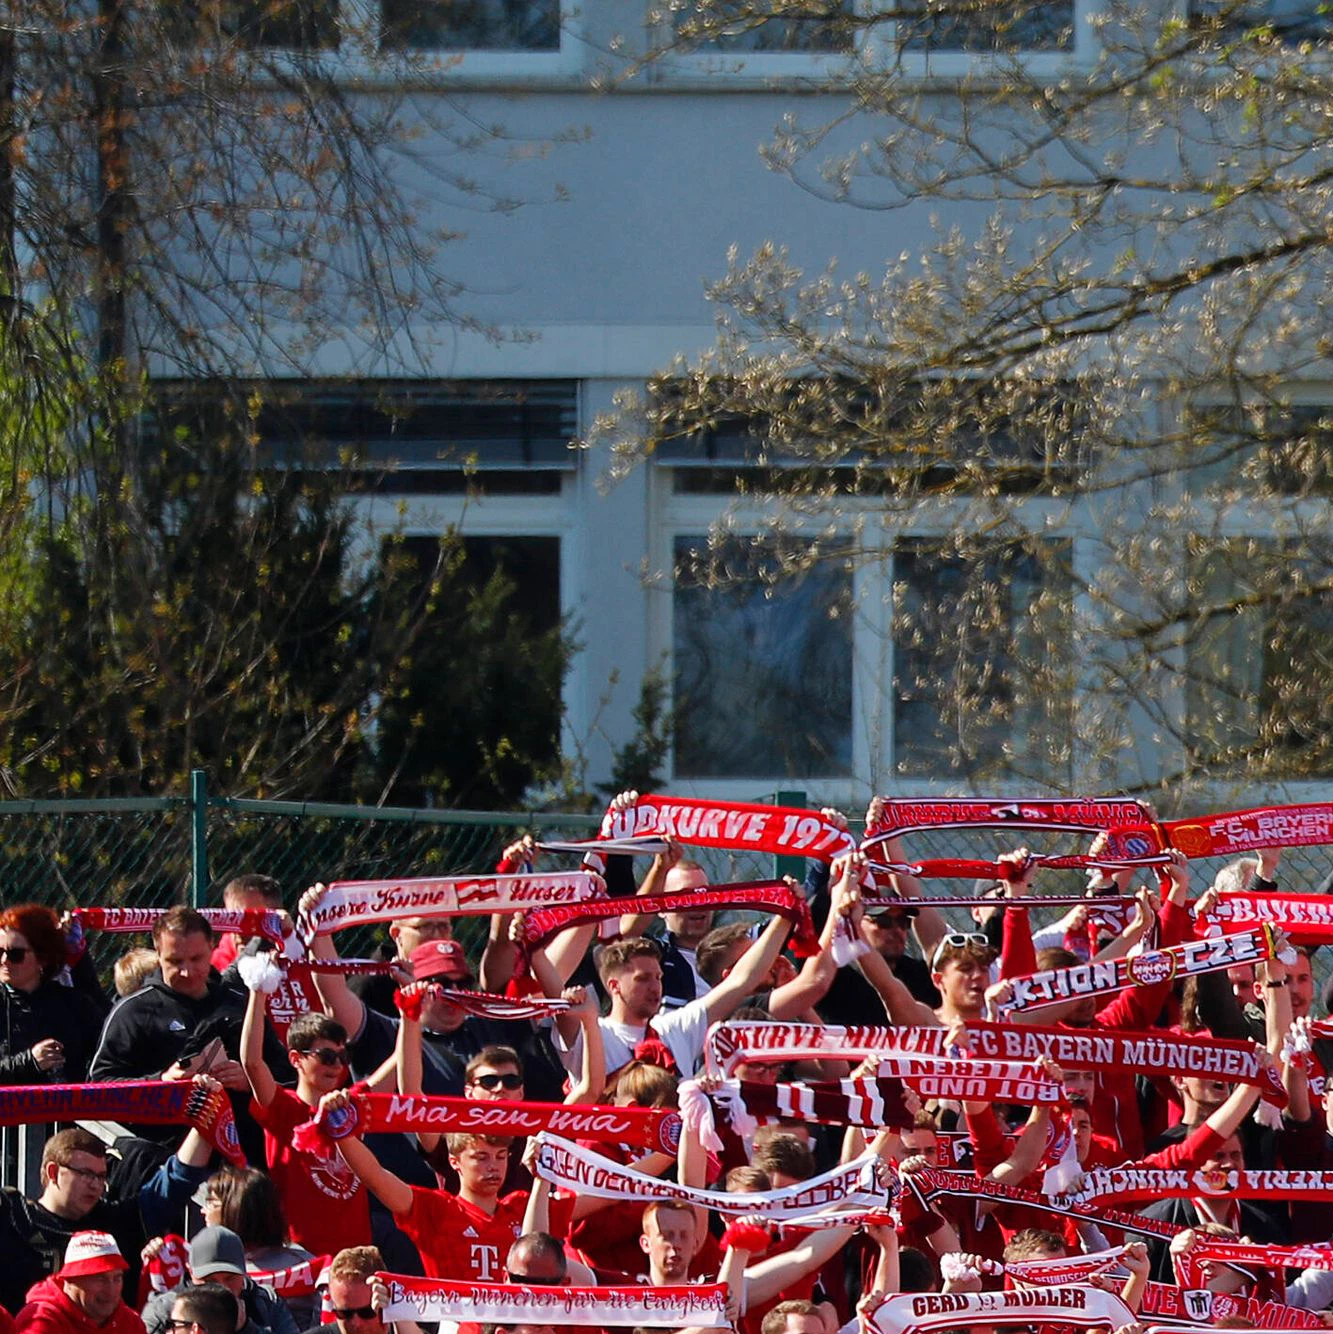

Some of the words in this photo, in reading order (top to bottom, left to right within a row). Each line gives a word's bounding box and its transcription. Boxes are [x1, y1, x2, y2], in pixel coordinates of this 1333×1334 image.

[968, 1037, 999, 1057] FC
[1004, 1030, 1116, 1067] BAYERN
[1120, 1034, 1261, 1078] MÜNCHEN
[919, 1077, 988, 1097] UND
[995, 1080, 1061, 1101] ROT
[386, 1096, 460, 1125] Mia
[464, 1104, 551, 1127] san
[546, 1108, 632, 1134] mia
[387, 1280, 461, 1308] Bayern
[612, 1287, 636, 1310] die
[912, 1293, 969, 1318] GERD
